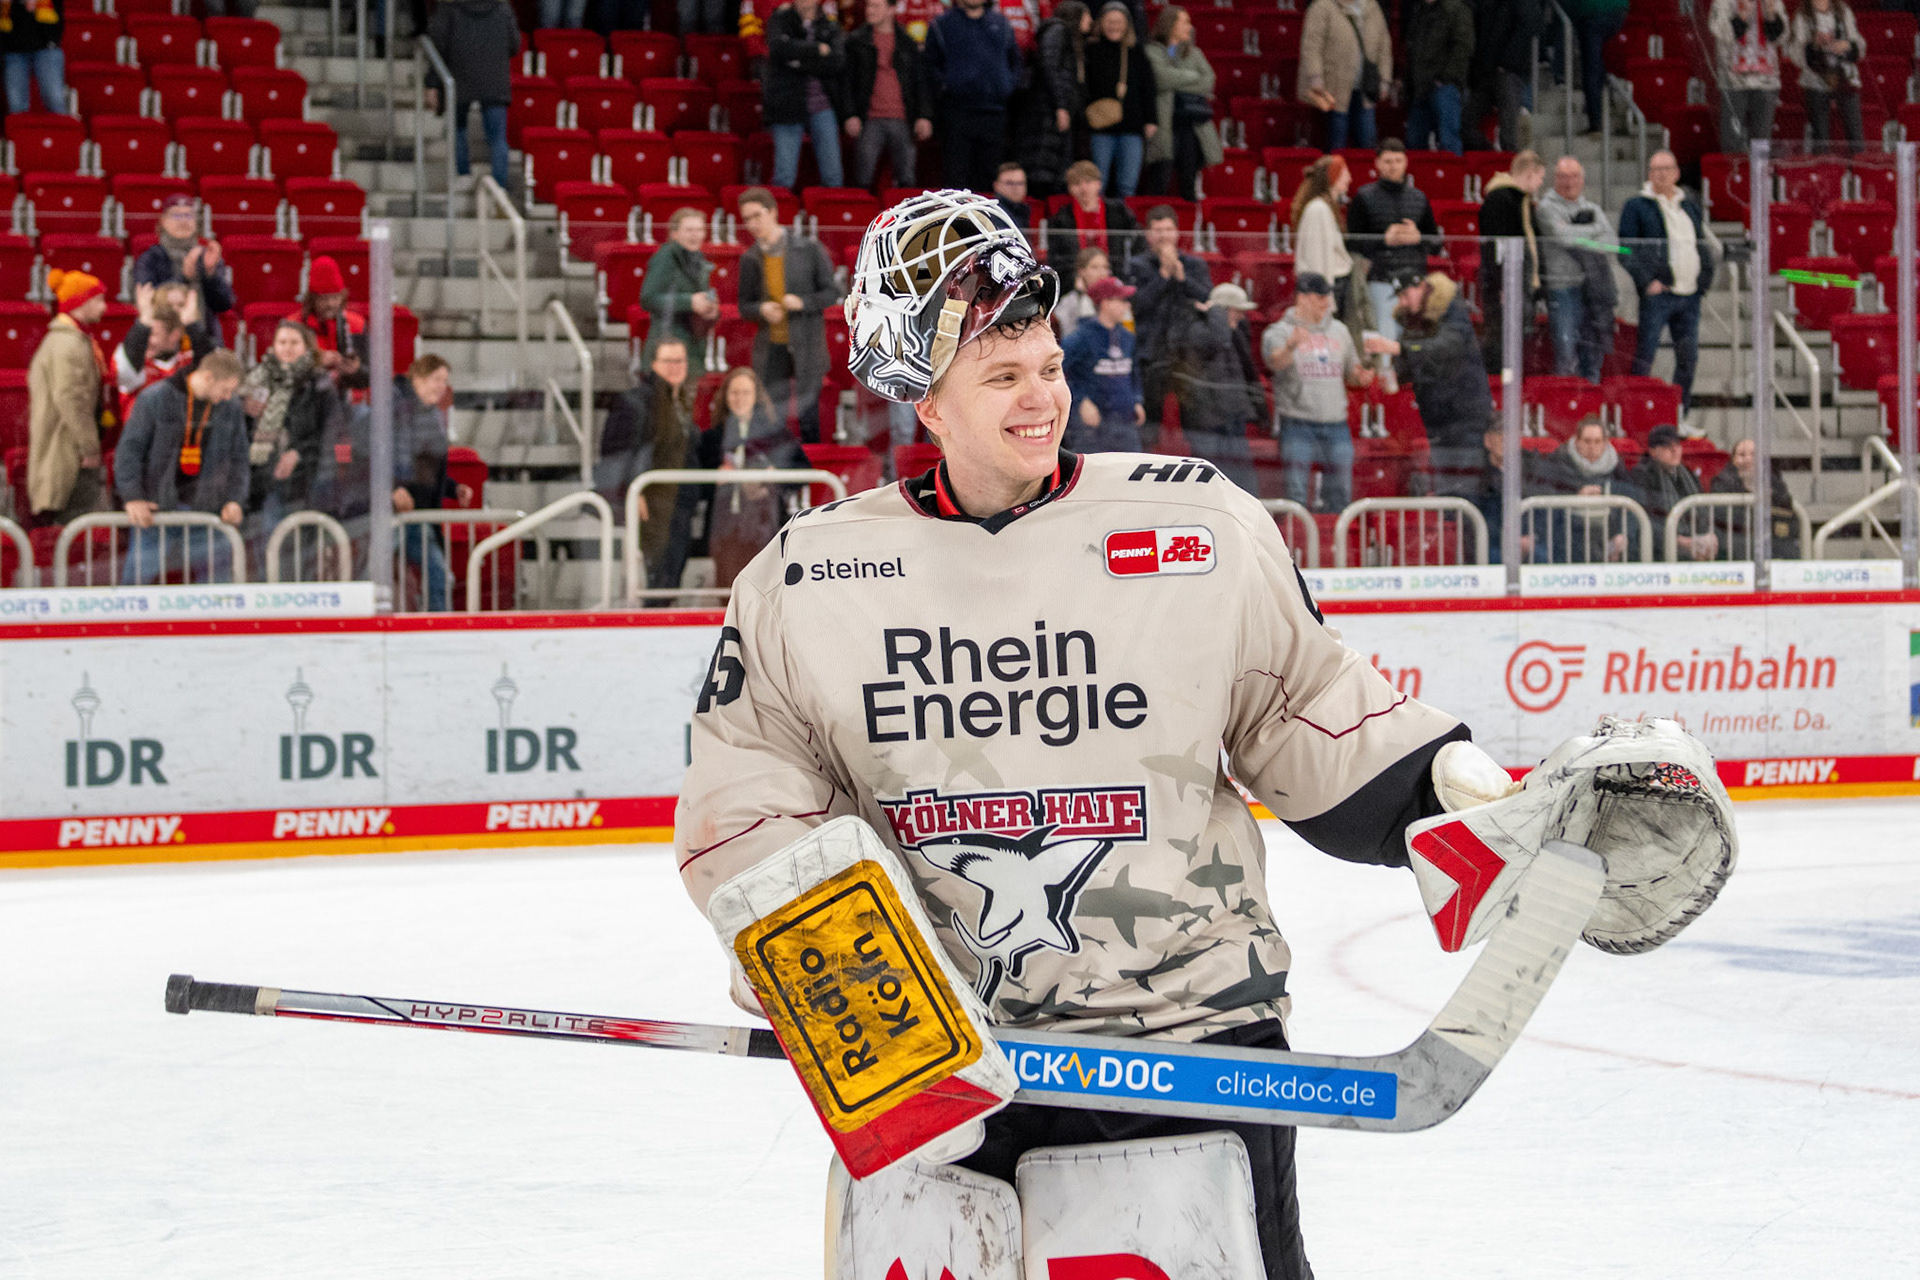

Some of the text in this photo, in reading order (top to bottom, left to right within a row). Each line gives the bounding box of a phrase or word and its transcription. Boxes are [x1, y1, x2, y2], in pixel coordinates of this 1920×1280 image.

[1169, 536, 1200, 549] 30
[810, 557, 906, 581] steinel
[884, 620, 1097, 685] Rhein
[1602, 645, 1837, 694] Rheinbahn
[862, 681, 1148, 747] Energie
[1702, 711, 1783, 733] Immer.
[1793, 708, 1830, 731] Da.
[65, 738, 169, 788] IDR
[279, 732, 380, 781] IDR
[486, 727, 581, 773] IDR
[883, 793, 1143, 844] KÖLNER HAIE
[853, 931, 921, 1039] Köln
[800, 946, 879, 1077] Radio
[1010, 1049, 1376, 1107] ICK DOC clickdoc.de
